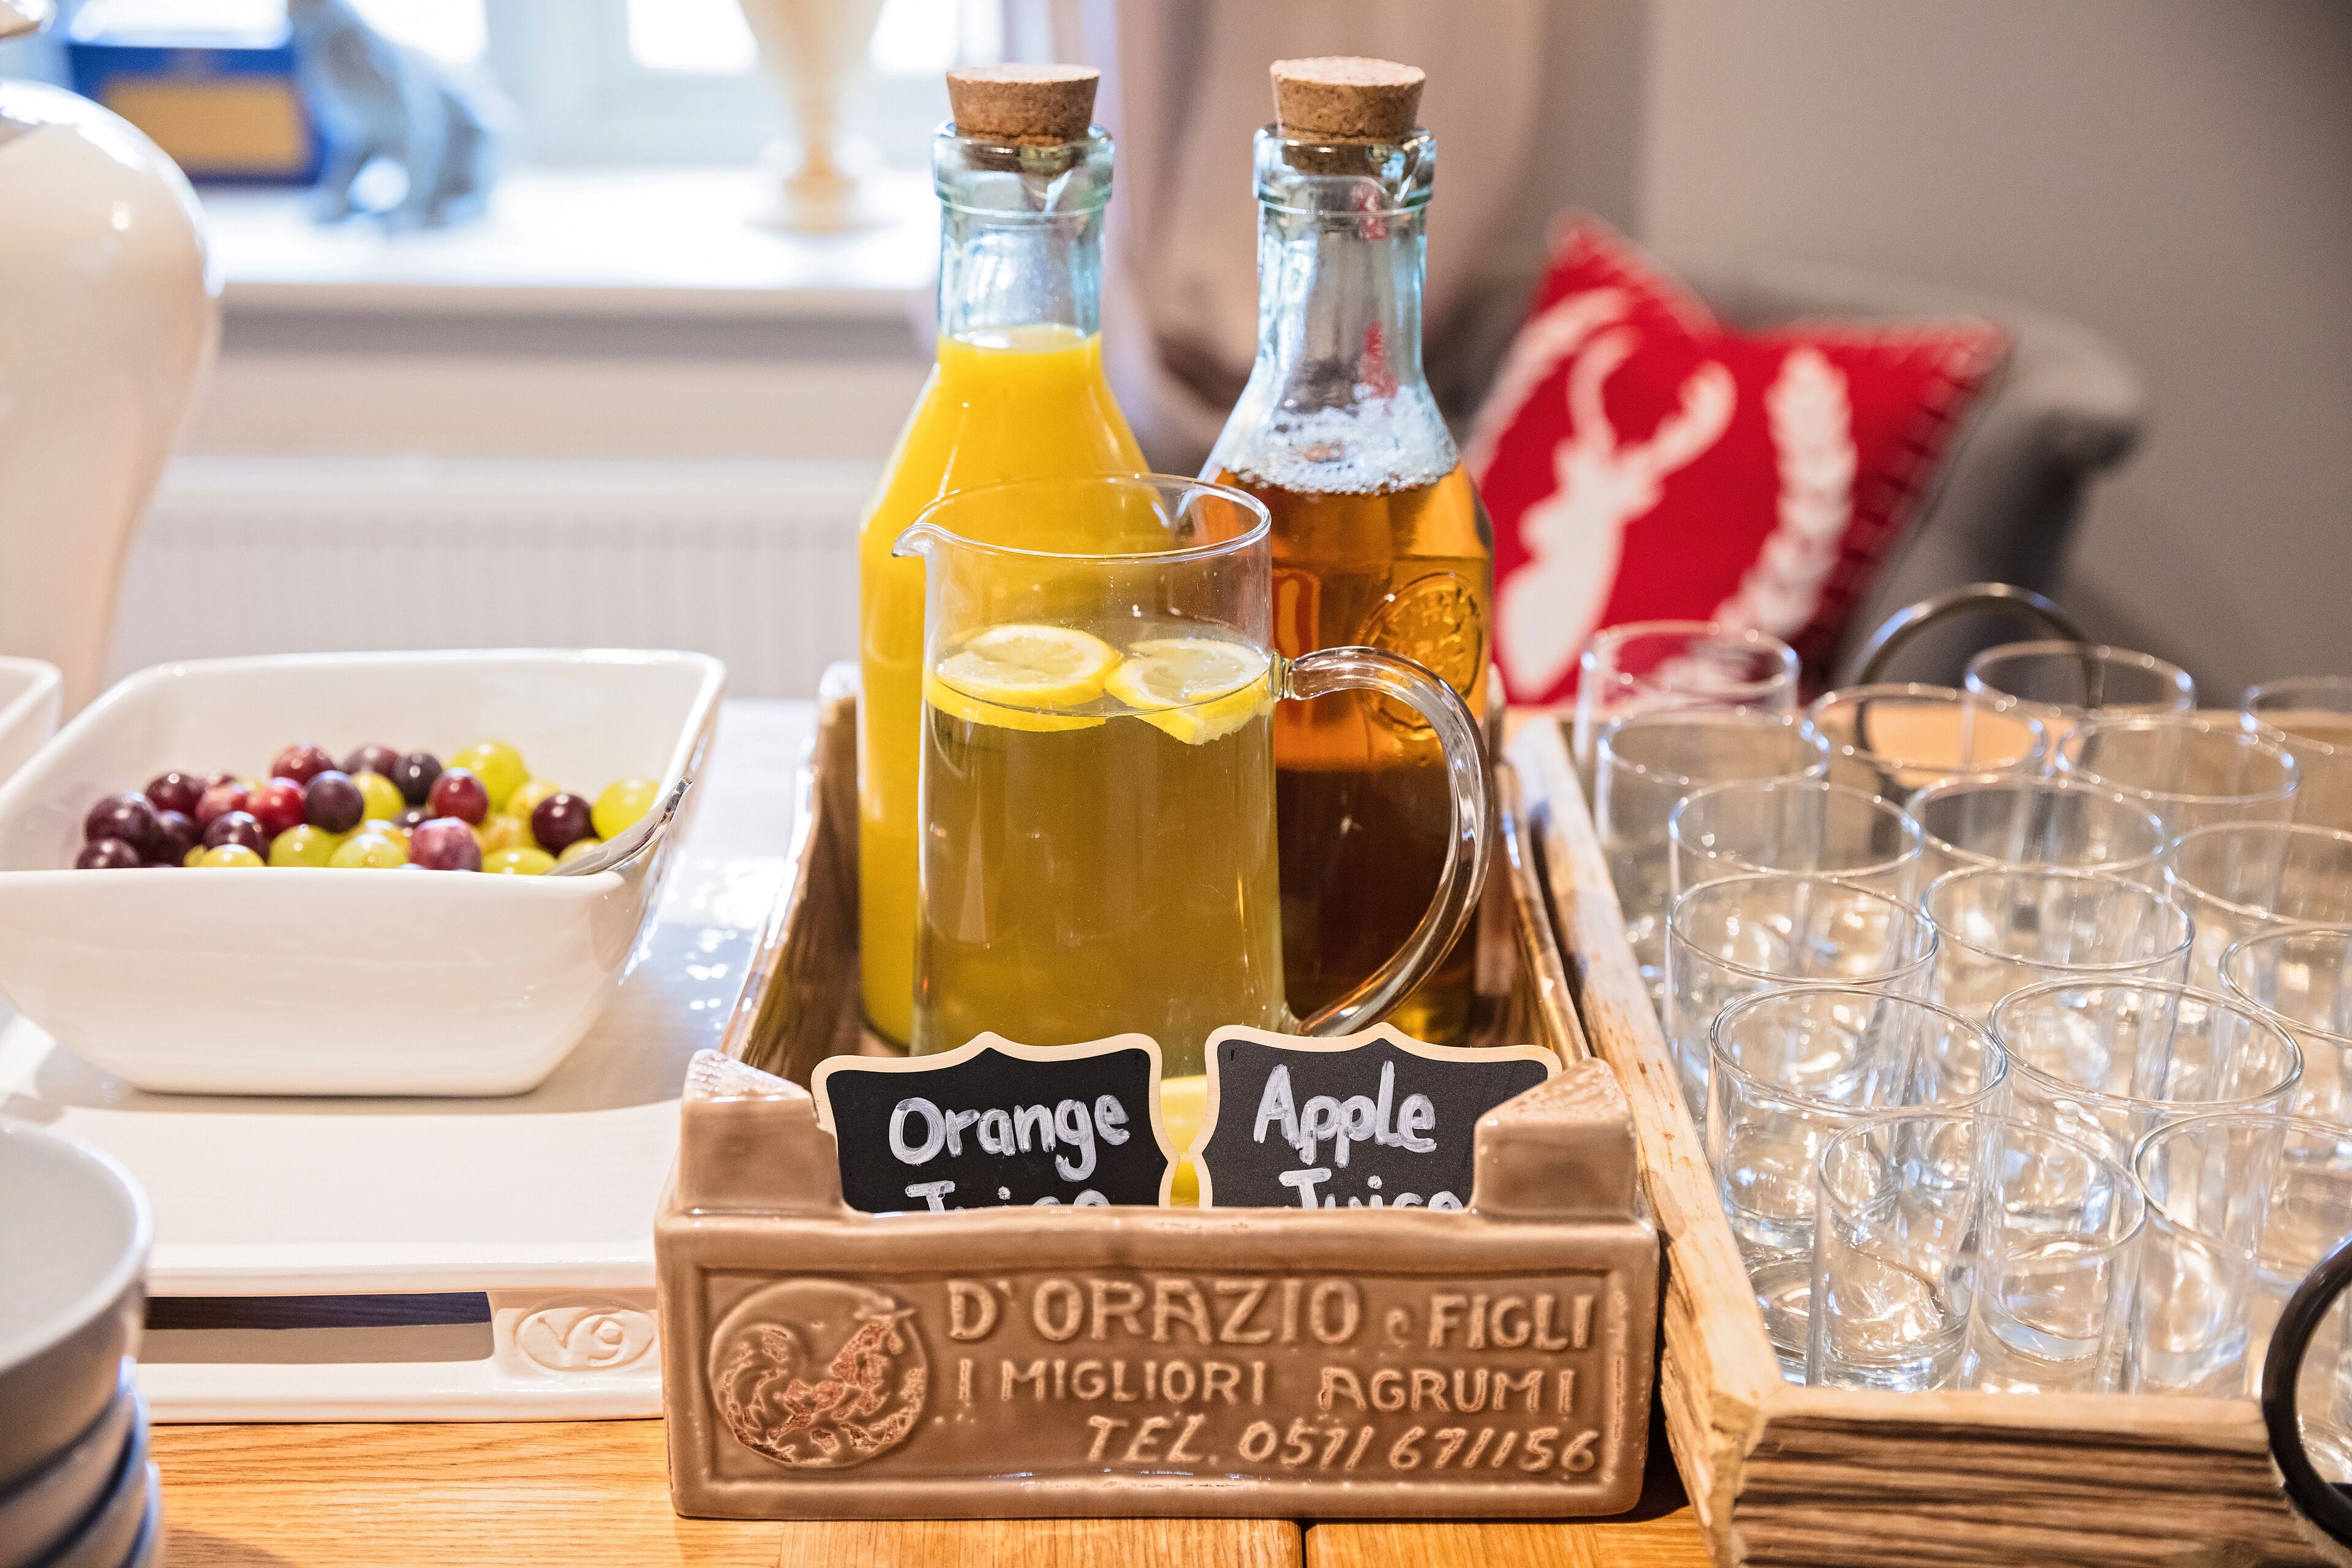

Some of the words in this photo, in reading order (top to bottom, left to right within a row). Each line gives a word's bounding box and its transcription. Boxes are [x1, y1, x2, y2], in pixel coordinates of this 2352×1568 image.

[889, 1094, 1131, 1183] Orange
[1253, 1060, 1438, 1168] Apple
[947, 1277, 1361, 1344] D'ORAZIO
[1428, 1293, 1594, 1350] FIGLI
[958, 1359, 972, 1401] I
[1000, 1359, 1266, 1405] MIGLIORI
[1318, 1367, 1575, 1412] AGRUMI
[1087, 1412, 1219, 1466] TEL.
